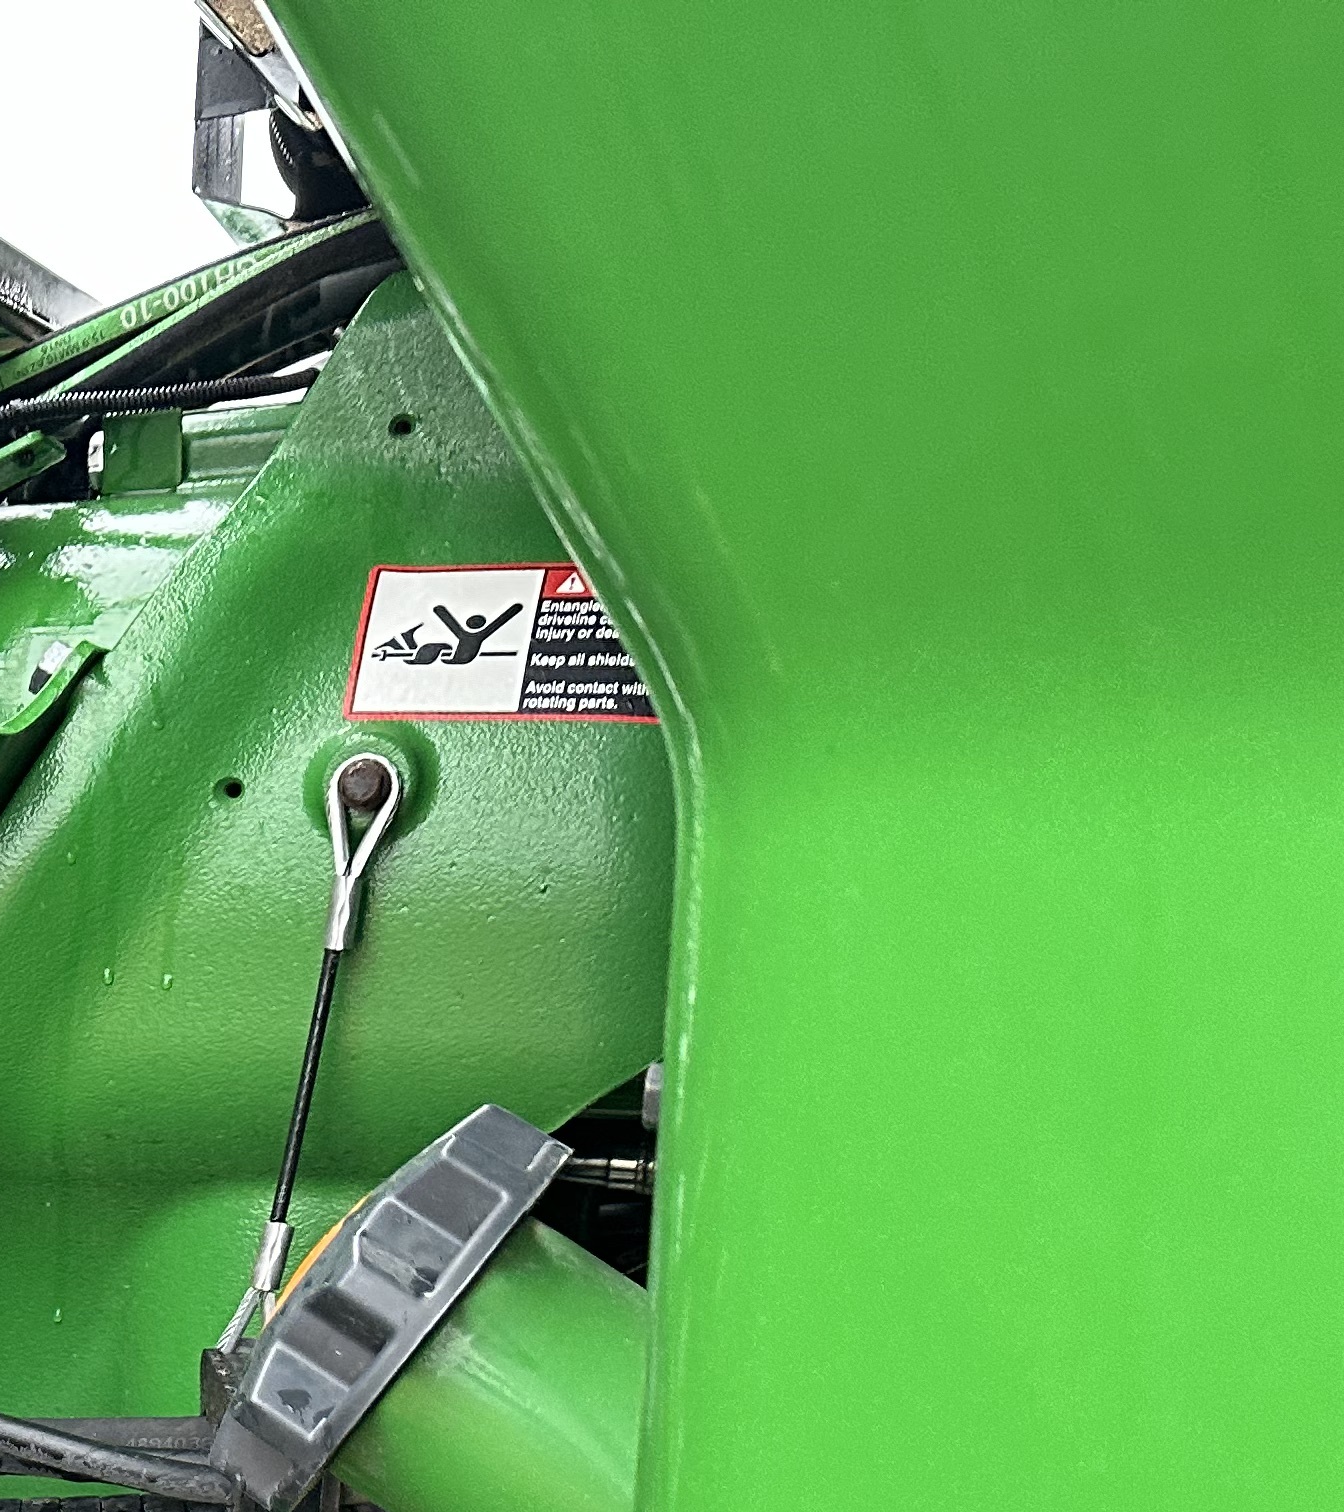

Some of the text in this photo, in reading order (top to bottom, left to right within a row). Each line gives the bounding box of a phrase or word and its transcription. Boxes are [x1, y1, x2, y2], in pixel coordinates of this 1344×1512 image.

[540, 600, 604, 614] Entangle
[537, 612, 597, 626] driveline
[535, 626, 574, 642] injury
[577, 628, 592, 639] or
[530, 653, 565, 669] Keep
[568, 653, 585, 666] all
[525, 680, 566, 694] Avoid
[567, 681, 619, 695] contact
[523, 695, 618, 711] rotating parts.
